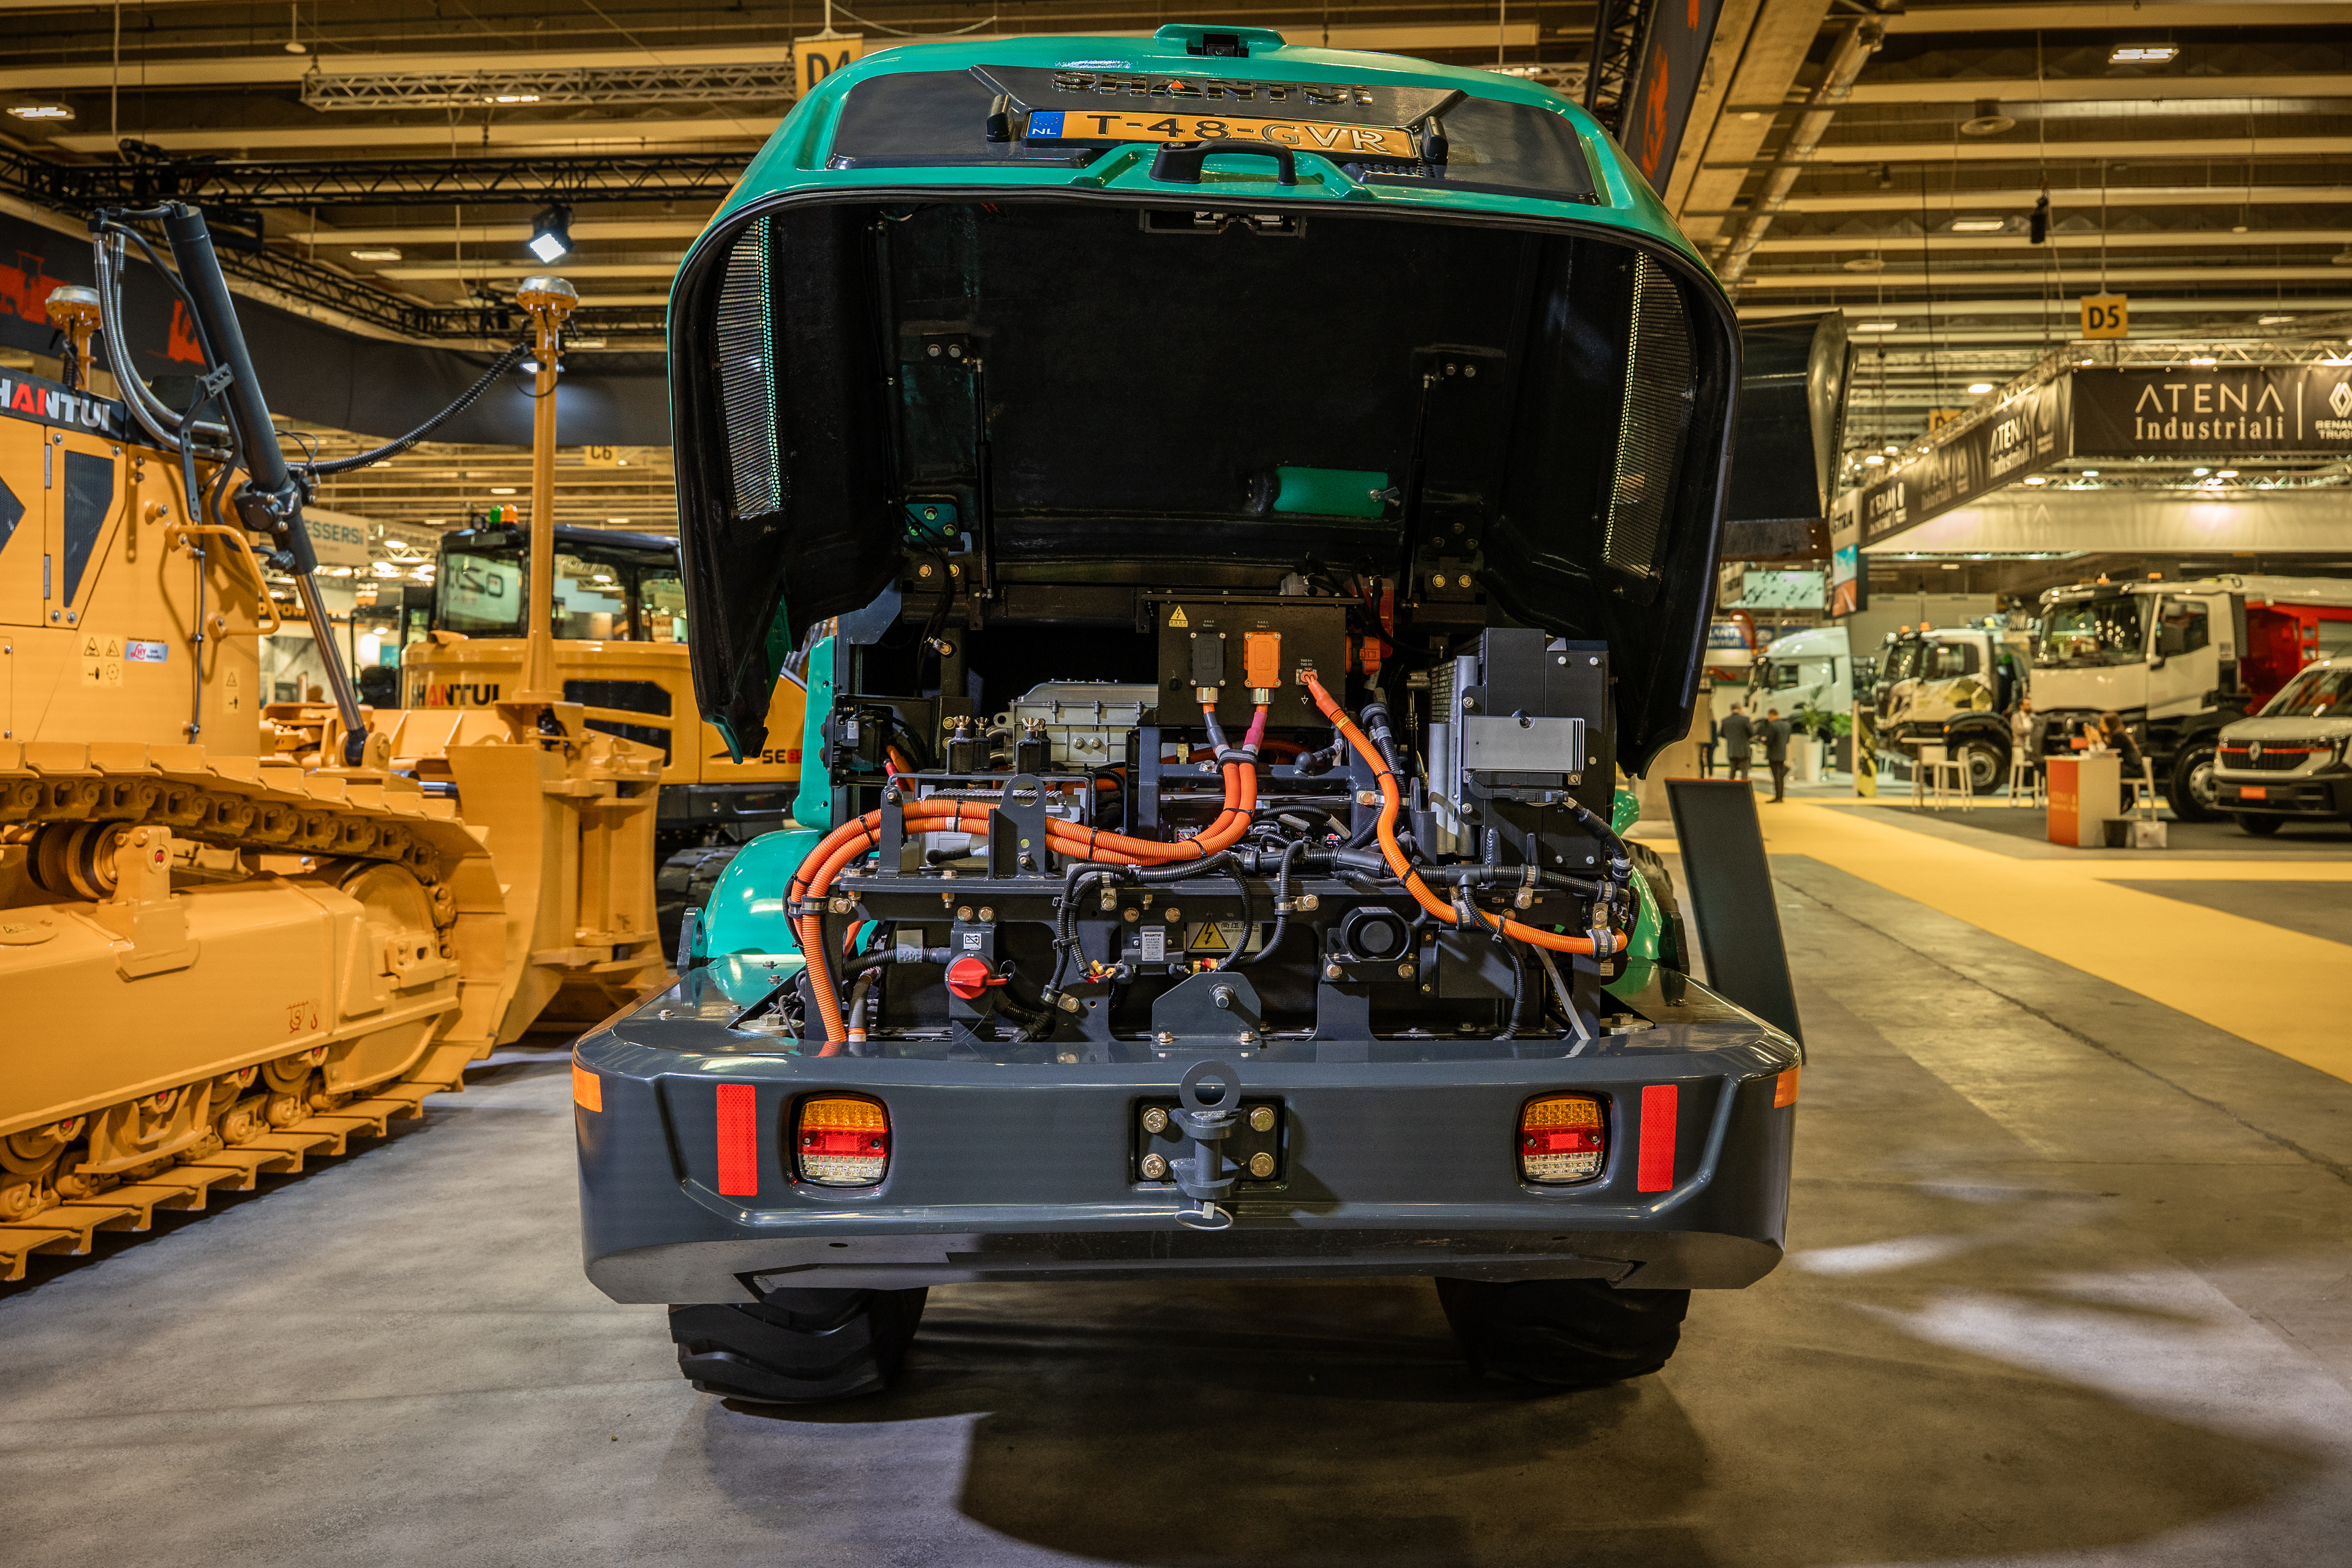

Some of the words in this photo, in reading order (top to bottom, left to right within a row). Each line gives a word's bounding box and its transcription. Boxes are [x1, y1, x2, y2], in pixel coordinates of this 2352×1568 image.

[1052, 70, 1373, 107] SHANTUI
[1087, 115, 1392, 154] T-48-GVR
[2089, 305, 2119, 329] D5
[2135, 383, 2285, 413] ATENA
[2135, 416, 2285, 440] Industriali
